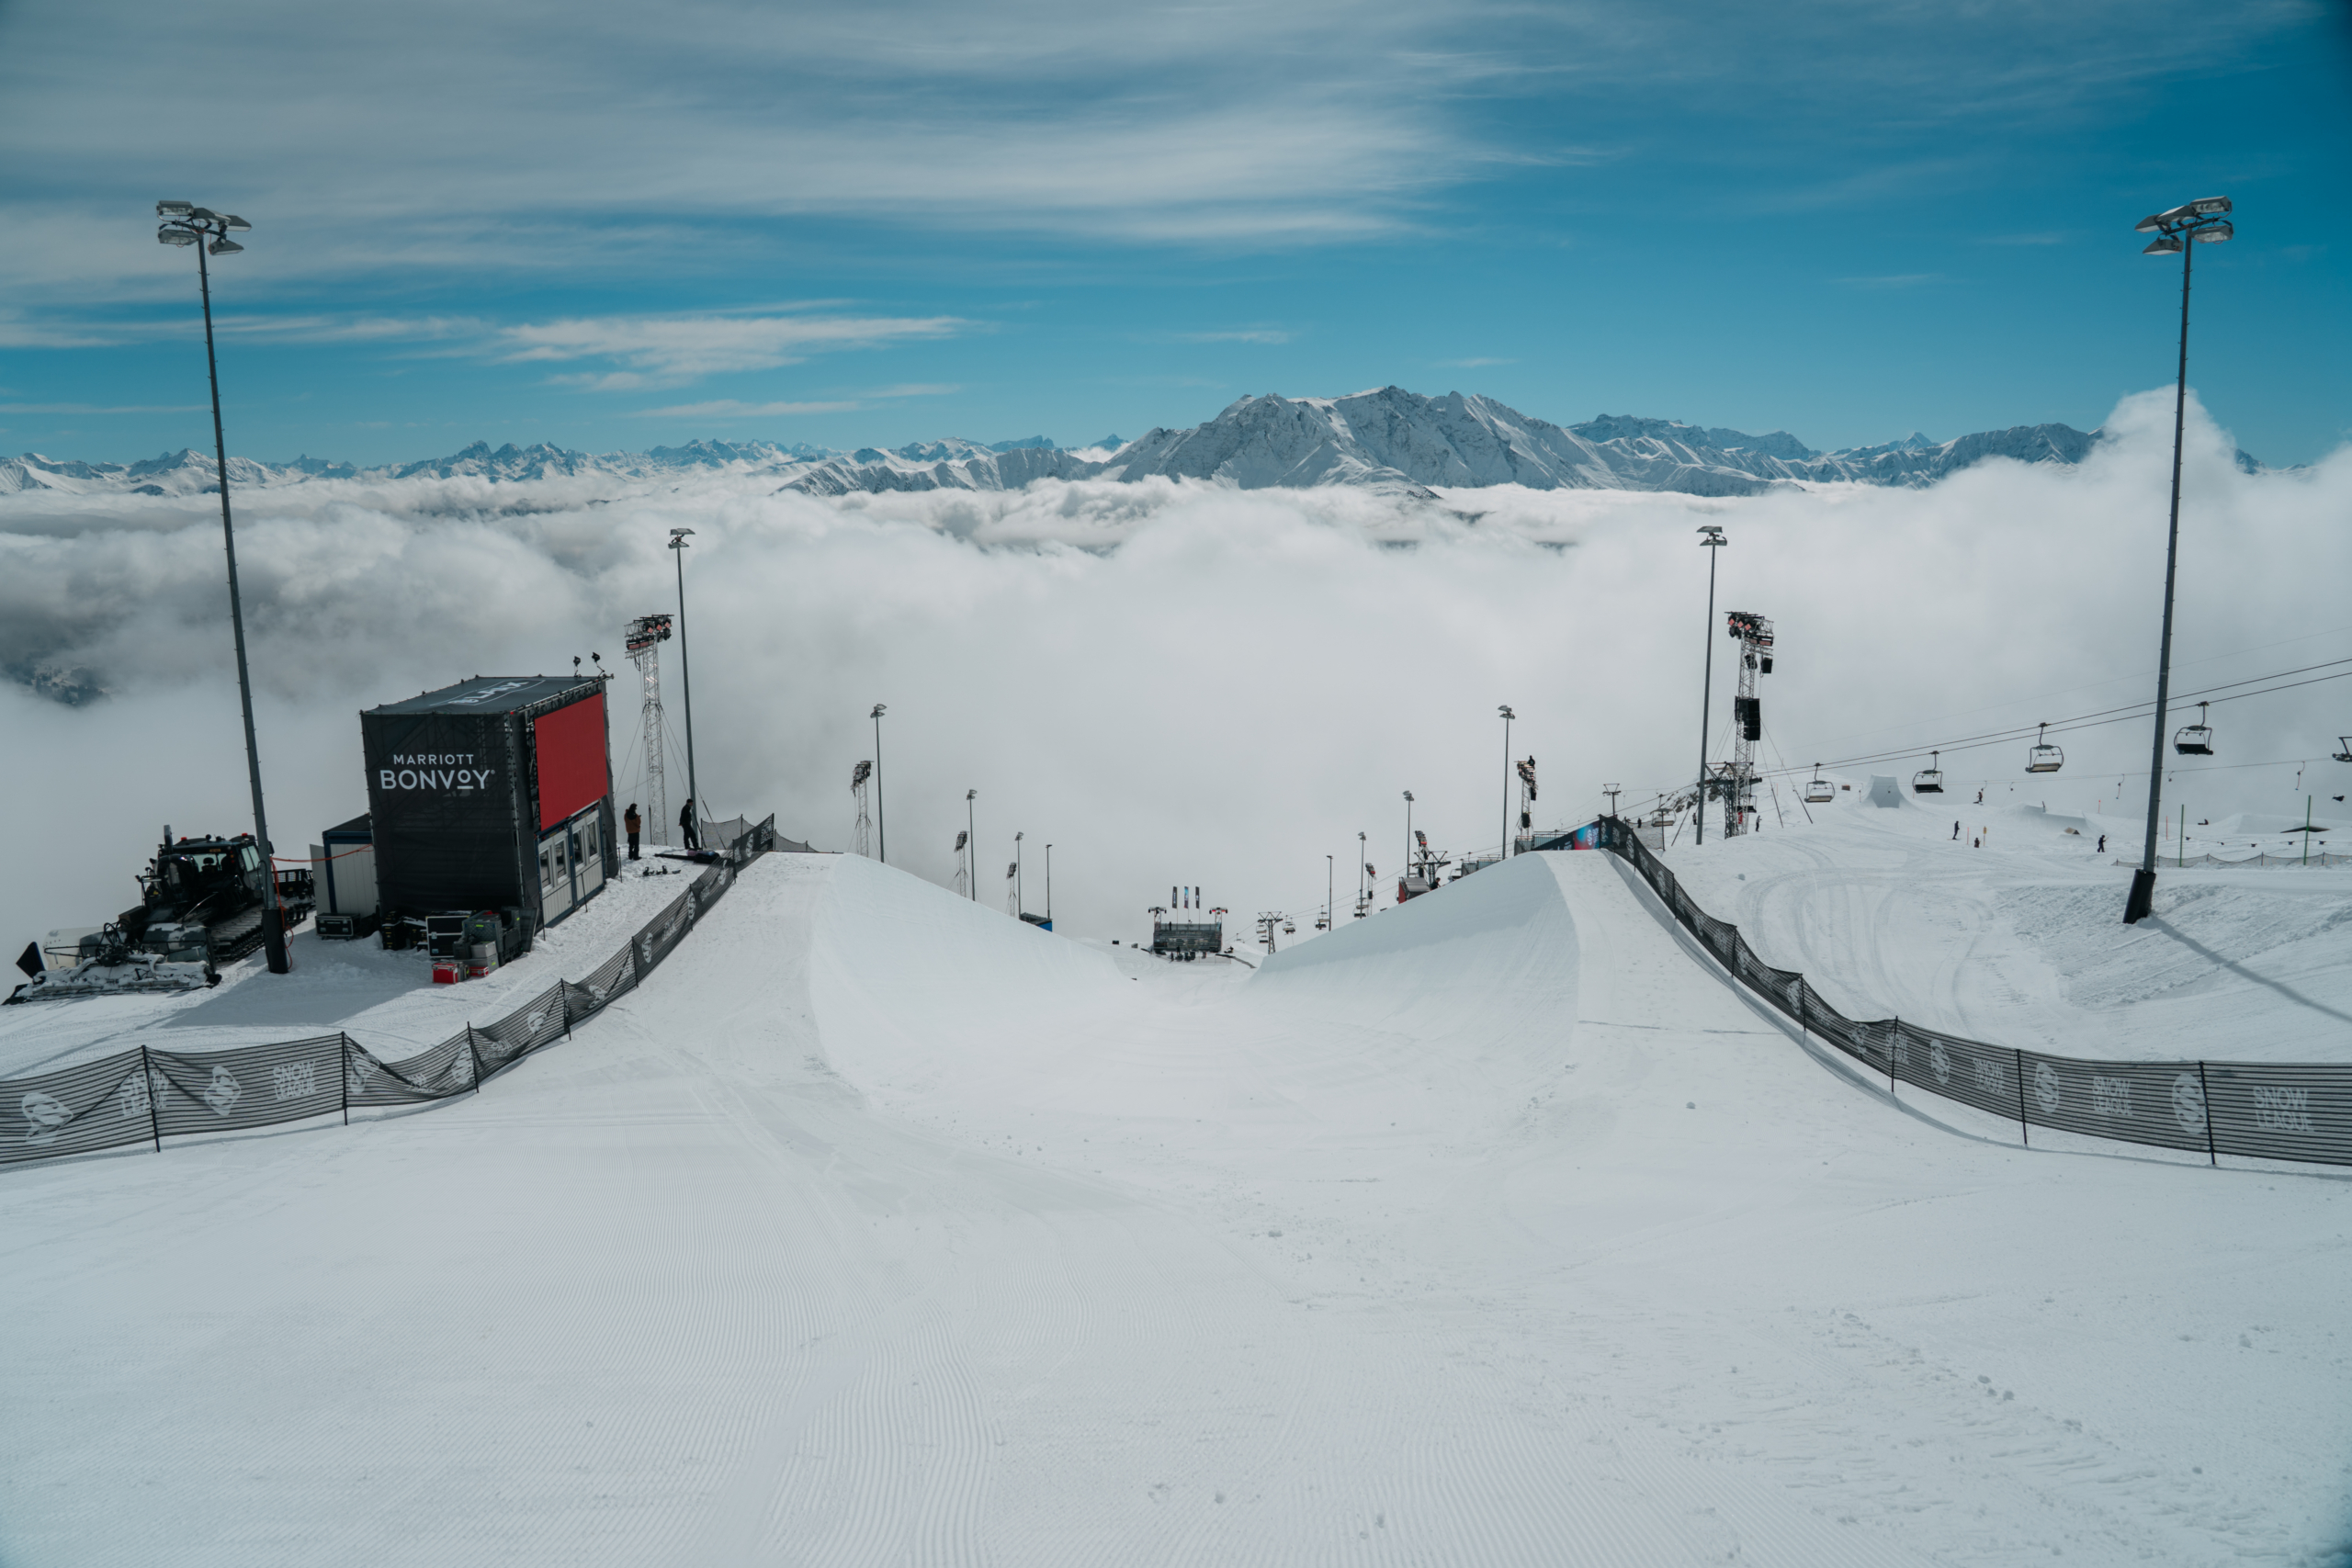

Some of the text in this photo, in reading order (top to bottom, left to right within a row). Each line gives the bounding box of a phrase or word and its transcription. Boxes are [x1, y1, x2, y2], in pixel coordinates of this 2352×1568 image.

[393, 754, 474, 765] MARRIOTT
[379, 769, 491, 790] BONVOY
[273, 1060, 316, 1085] SNOW
[275, 1078, 316, 1100] LEAGUE
[2092, 1076, 2132, 1099] SNOW
[2253, 1086, 2308, 1111] SNOW
[2092, 1096, 2133, 1116] LEAGUE
[2255, 1109, 2315, 1133] LEAGUE
